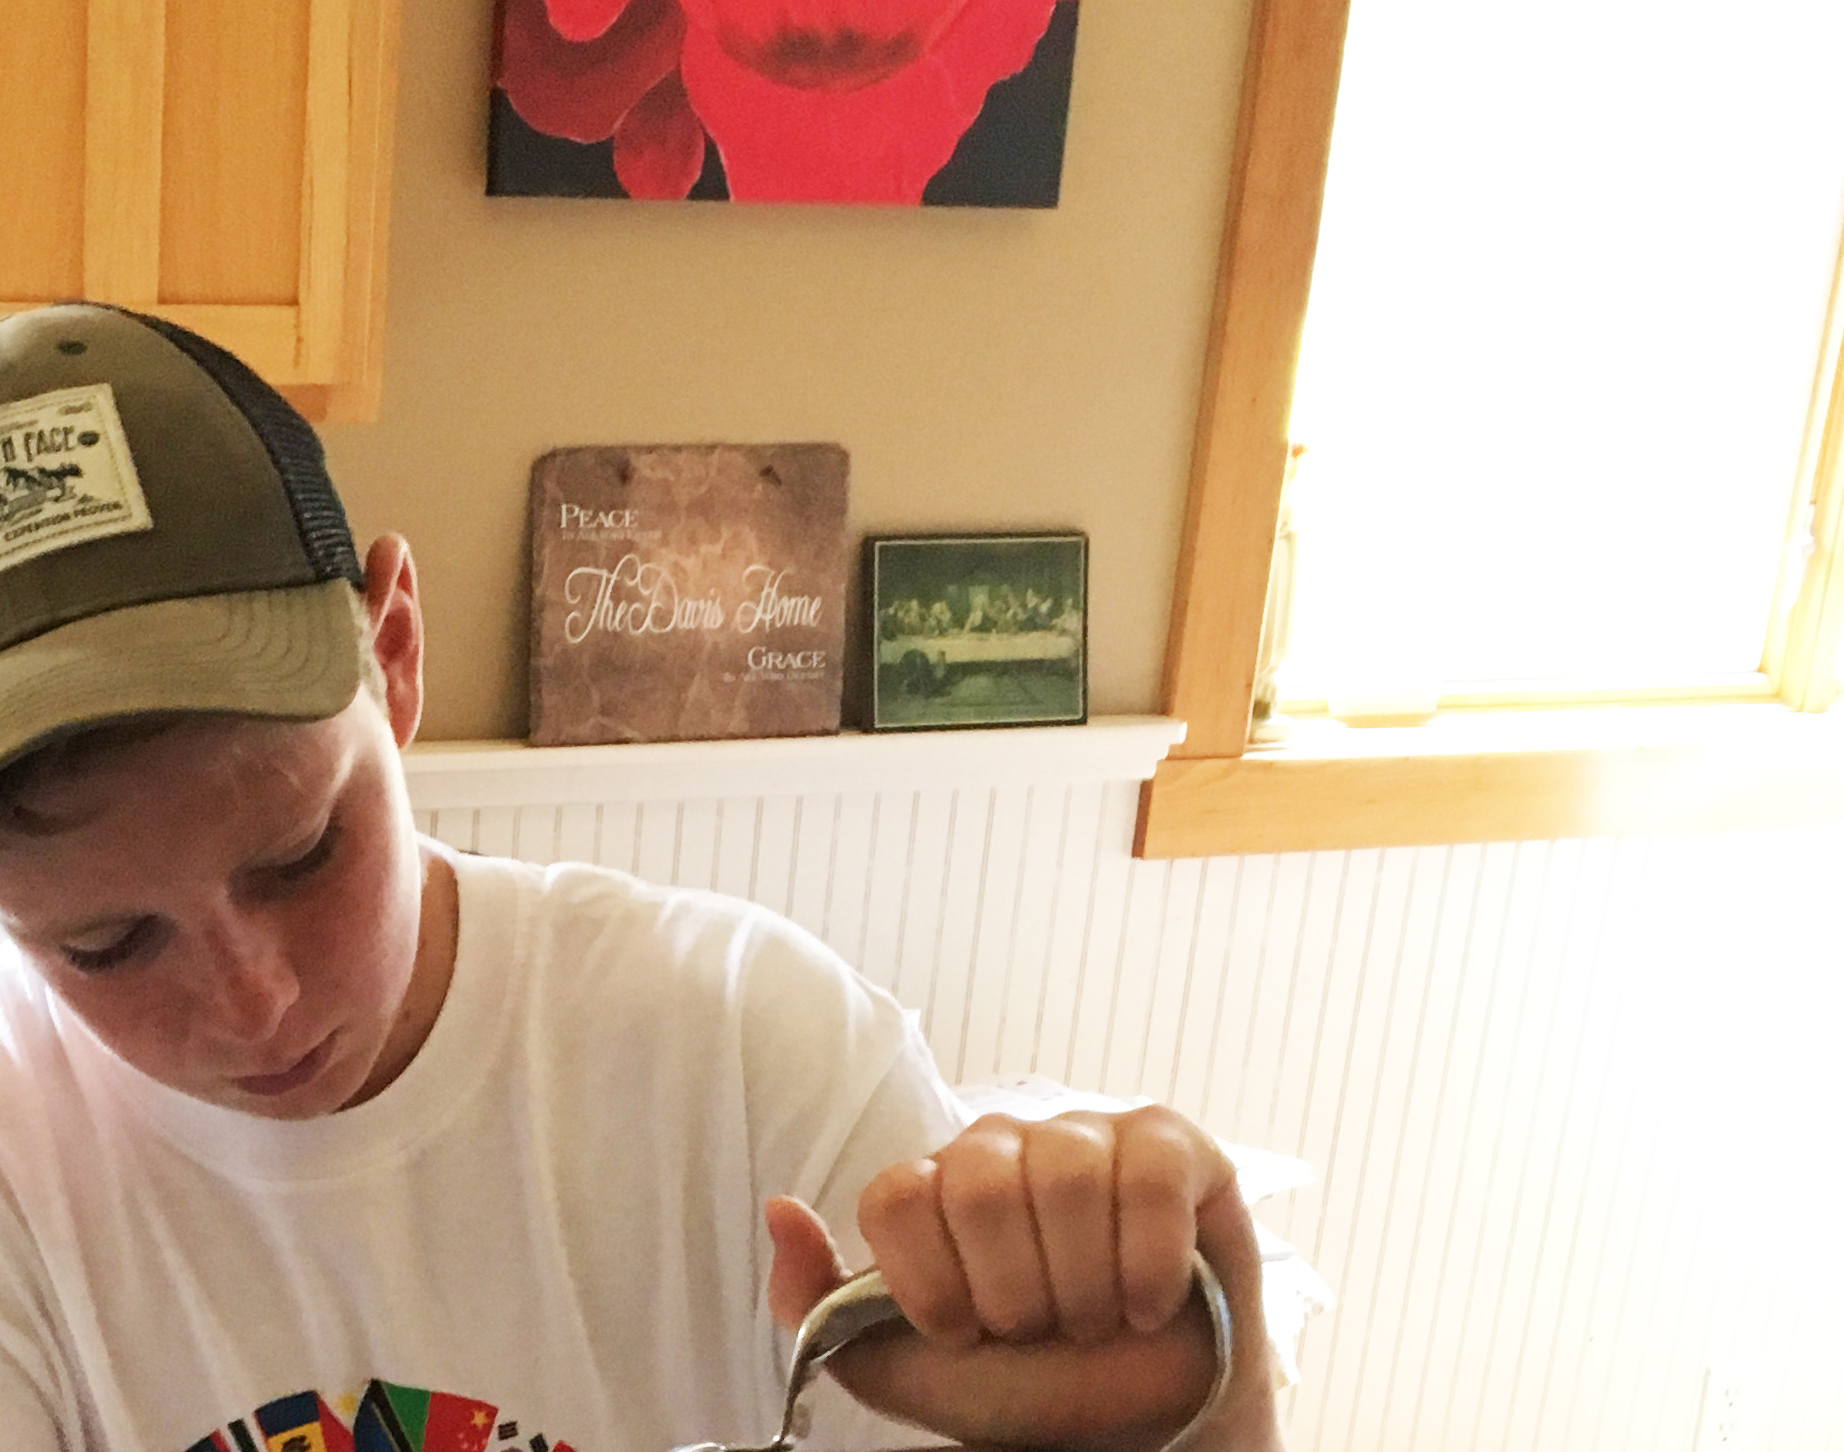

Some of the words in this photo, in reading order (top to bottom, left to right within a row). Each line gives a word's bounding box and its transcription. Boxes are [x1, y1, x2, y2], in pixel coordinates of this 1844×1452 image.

[23, 424, 78, 463] FACE
[560, 502, 639, 529] PEACE
[564, 553, 642, 644] The
[628, 562, 725, 636] Davis
[735, 563, 823, 635] Home
[747, 645, 827, 670] GRACE
